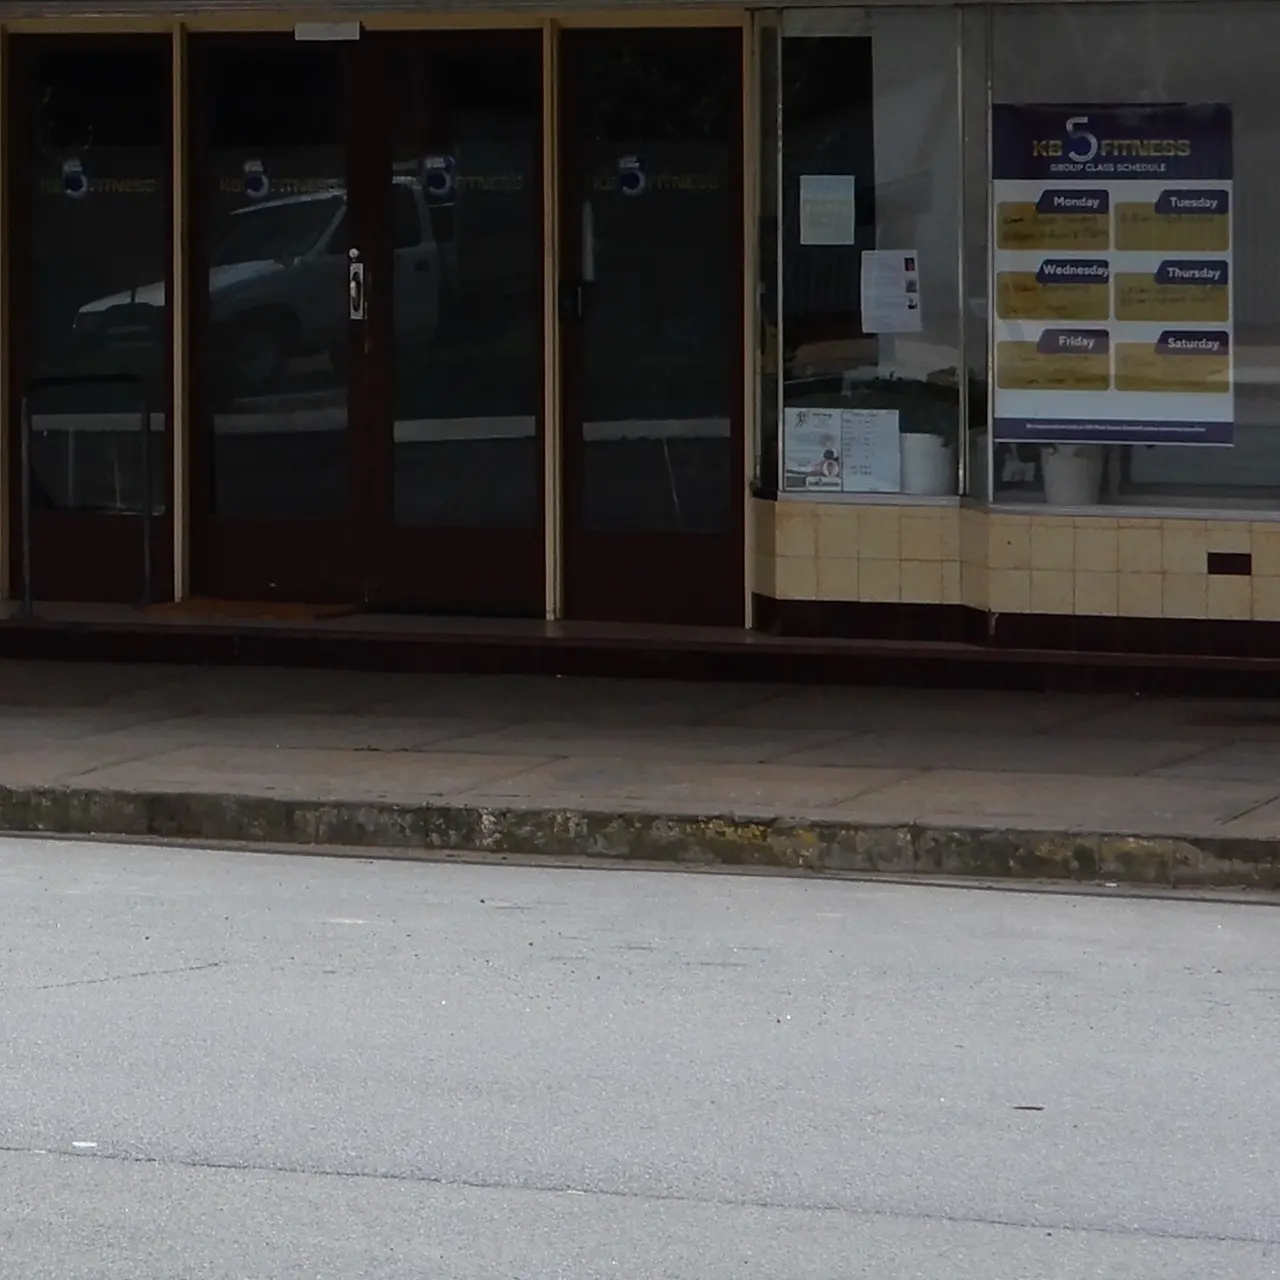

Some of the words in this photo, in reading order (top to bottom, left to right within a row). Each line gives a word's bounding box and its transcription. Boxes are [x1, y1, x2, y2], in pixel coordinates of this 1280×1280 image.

[1100, 139, 1192, 157] FITNESS
[1050, 163, 1084, 172] GROUP
[1085, 163, 1115, 173] CLASS
[1117, 163, 1167, 173] SCHEDULE
[1053, 196, 1100, 208] Monday
[1168, 196, 1219, 209] Tuesday
[1042, 264, 1109, 278] Wednesday
[1166, 267, 1222, 280] Thursday
[1058, 336, 1096, 349] Friday
[1167, 338, 1220, 351] Saturday
